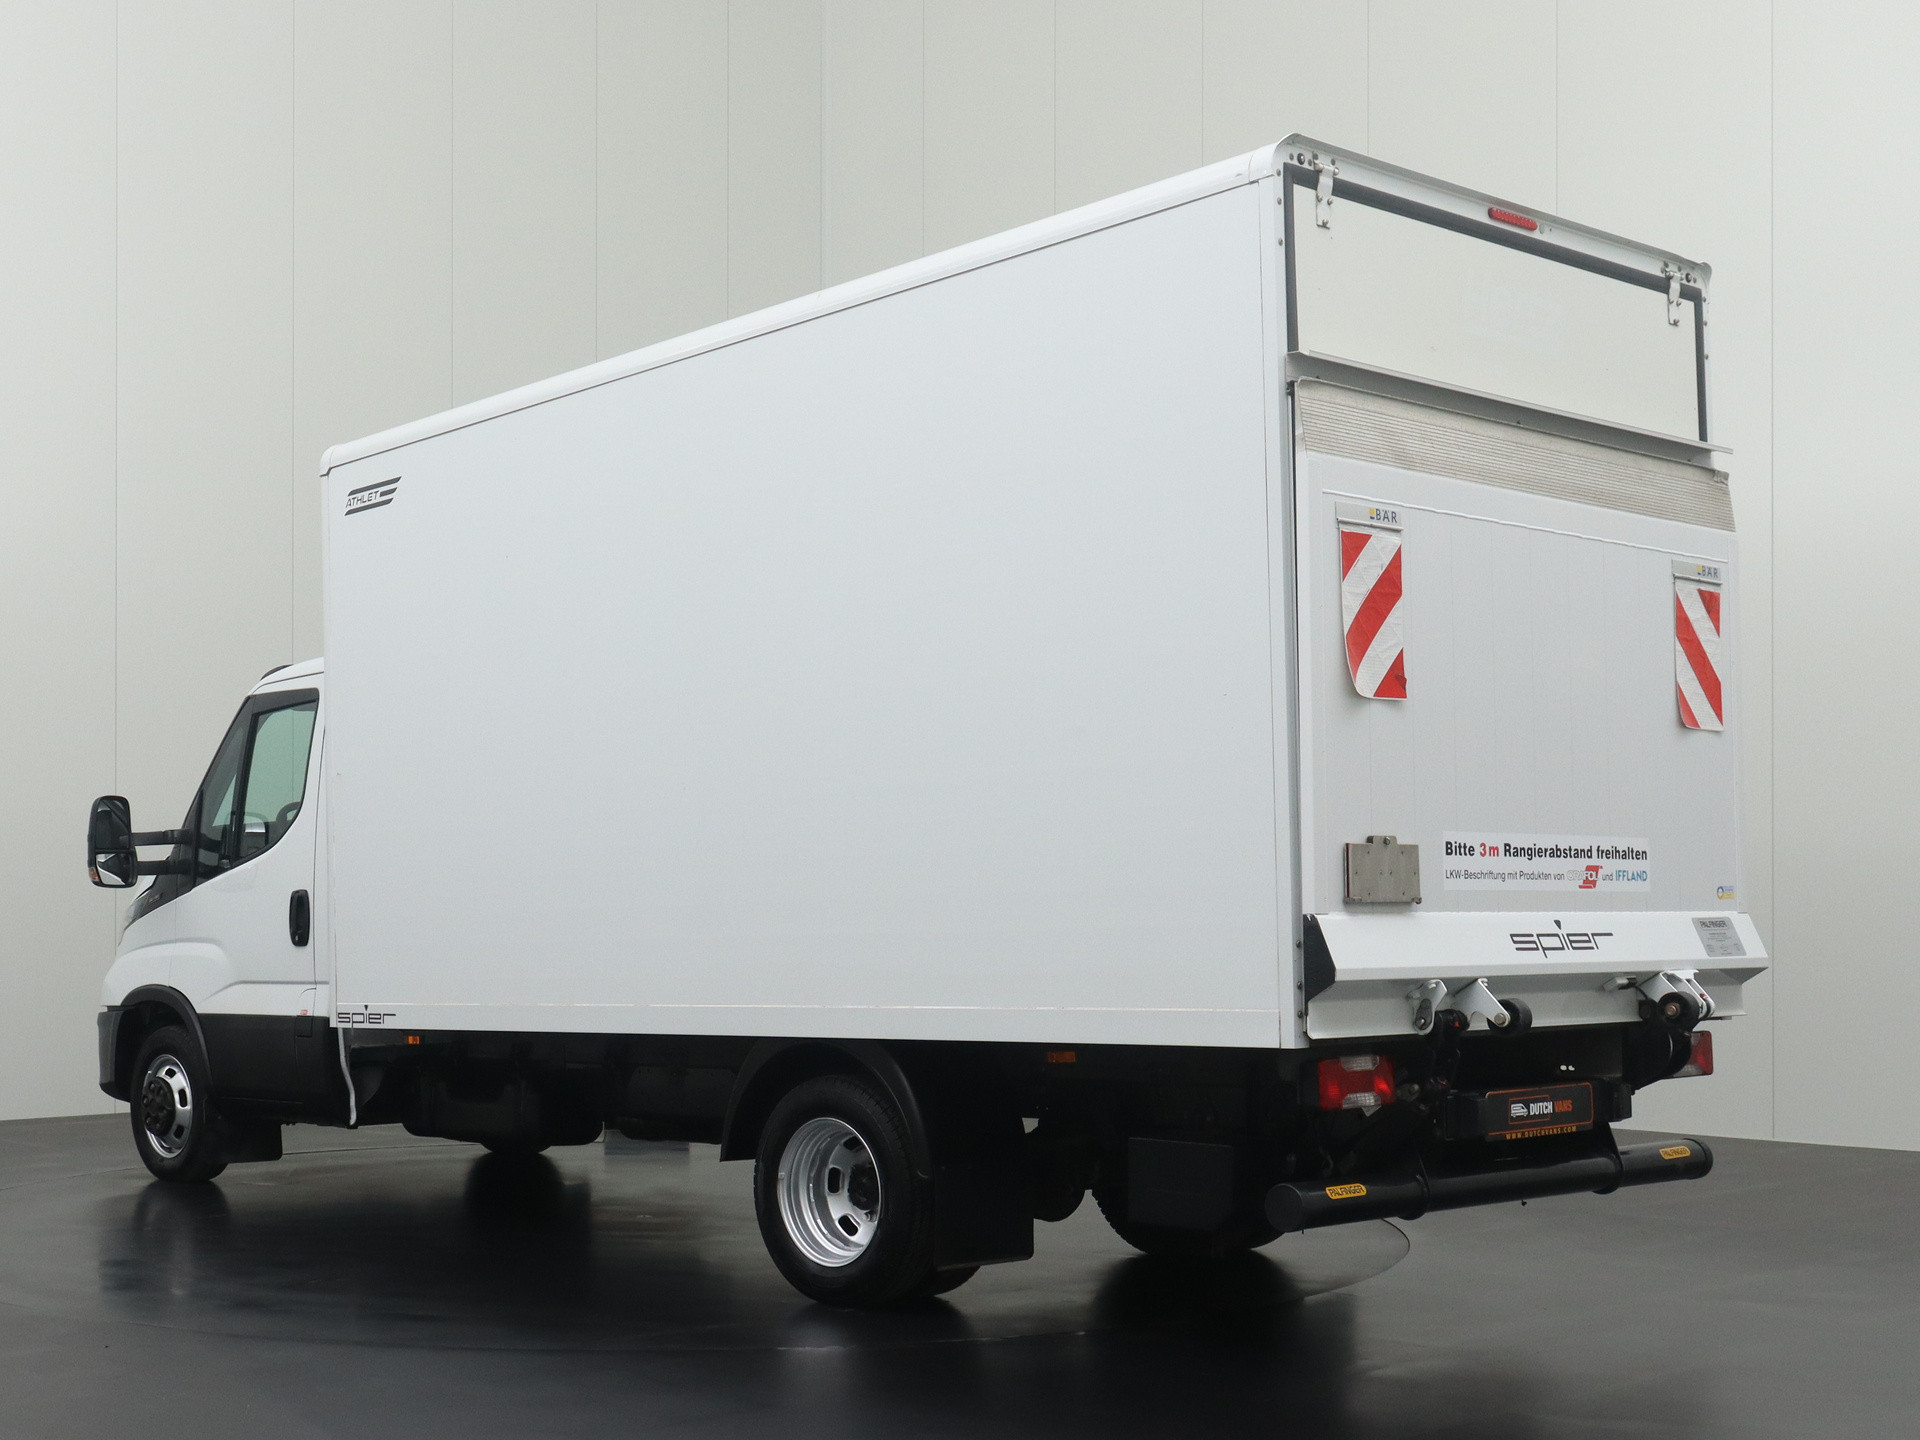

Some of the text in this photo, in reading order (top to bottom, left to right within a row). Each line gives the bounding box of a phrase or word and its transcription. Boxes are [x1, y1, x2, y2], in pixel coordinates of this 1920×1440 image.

[345, 490, 380, 508] ATHLET
[1375, 508, 1398, 524] BÄR
[1445, 841, 1475, 856] Bitte
[1503, 843, 1593, 861] Rangierabstand
[1596, 845, 1648, 861] freihalten
[1445, 869, 1506, 883] LKW-Beschriftung
[1507, 870, 1518, 880] mit
[1519, 870, 1552, 881] Produkten
[1553, 873, 1565, 881] von
[1602, 872, 1614, 881] und
[1615, 869, 1648, 882] IFFLAND
[1509, 919, 1614, 959] spier
[337, 1004, 397, 1029] spier
[1529, 1099, 1573, 1116] DUTCH VANS
[1506, 1125, 1577, 1140] WWW.DUTCHVANS.COM
